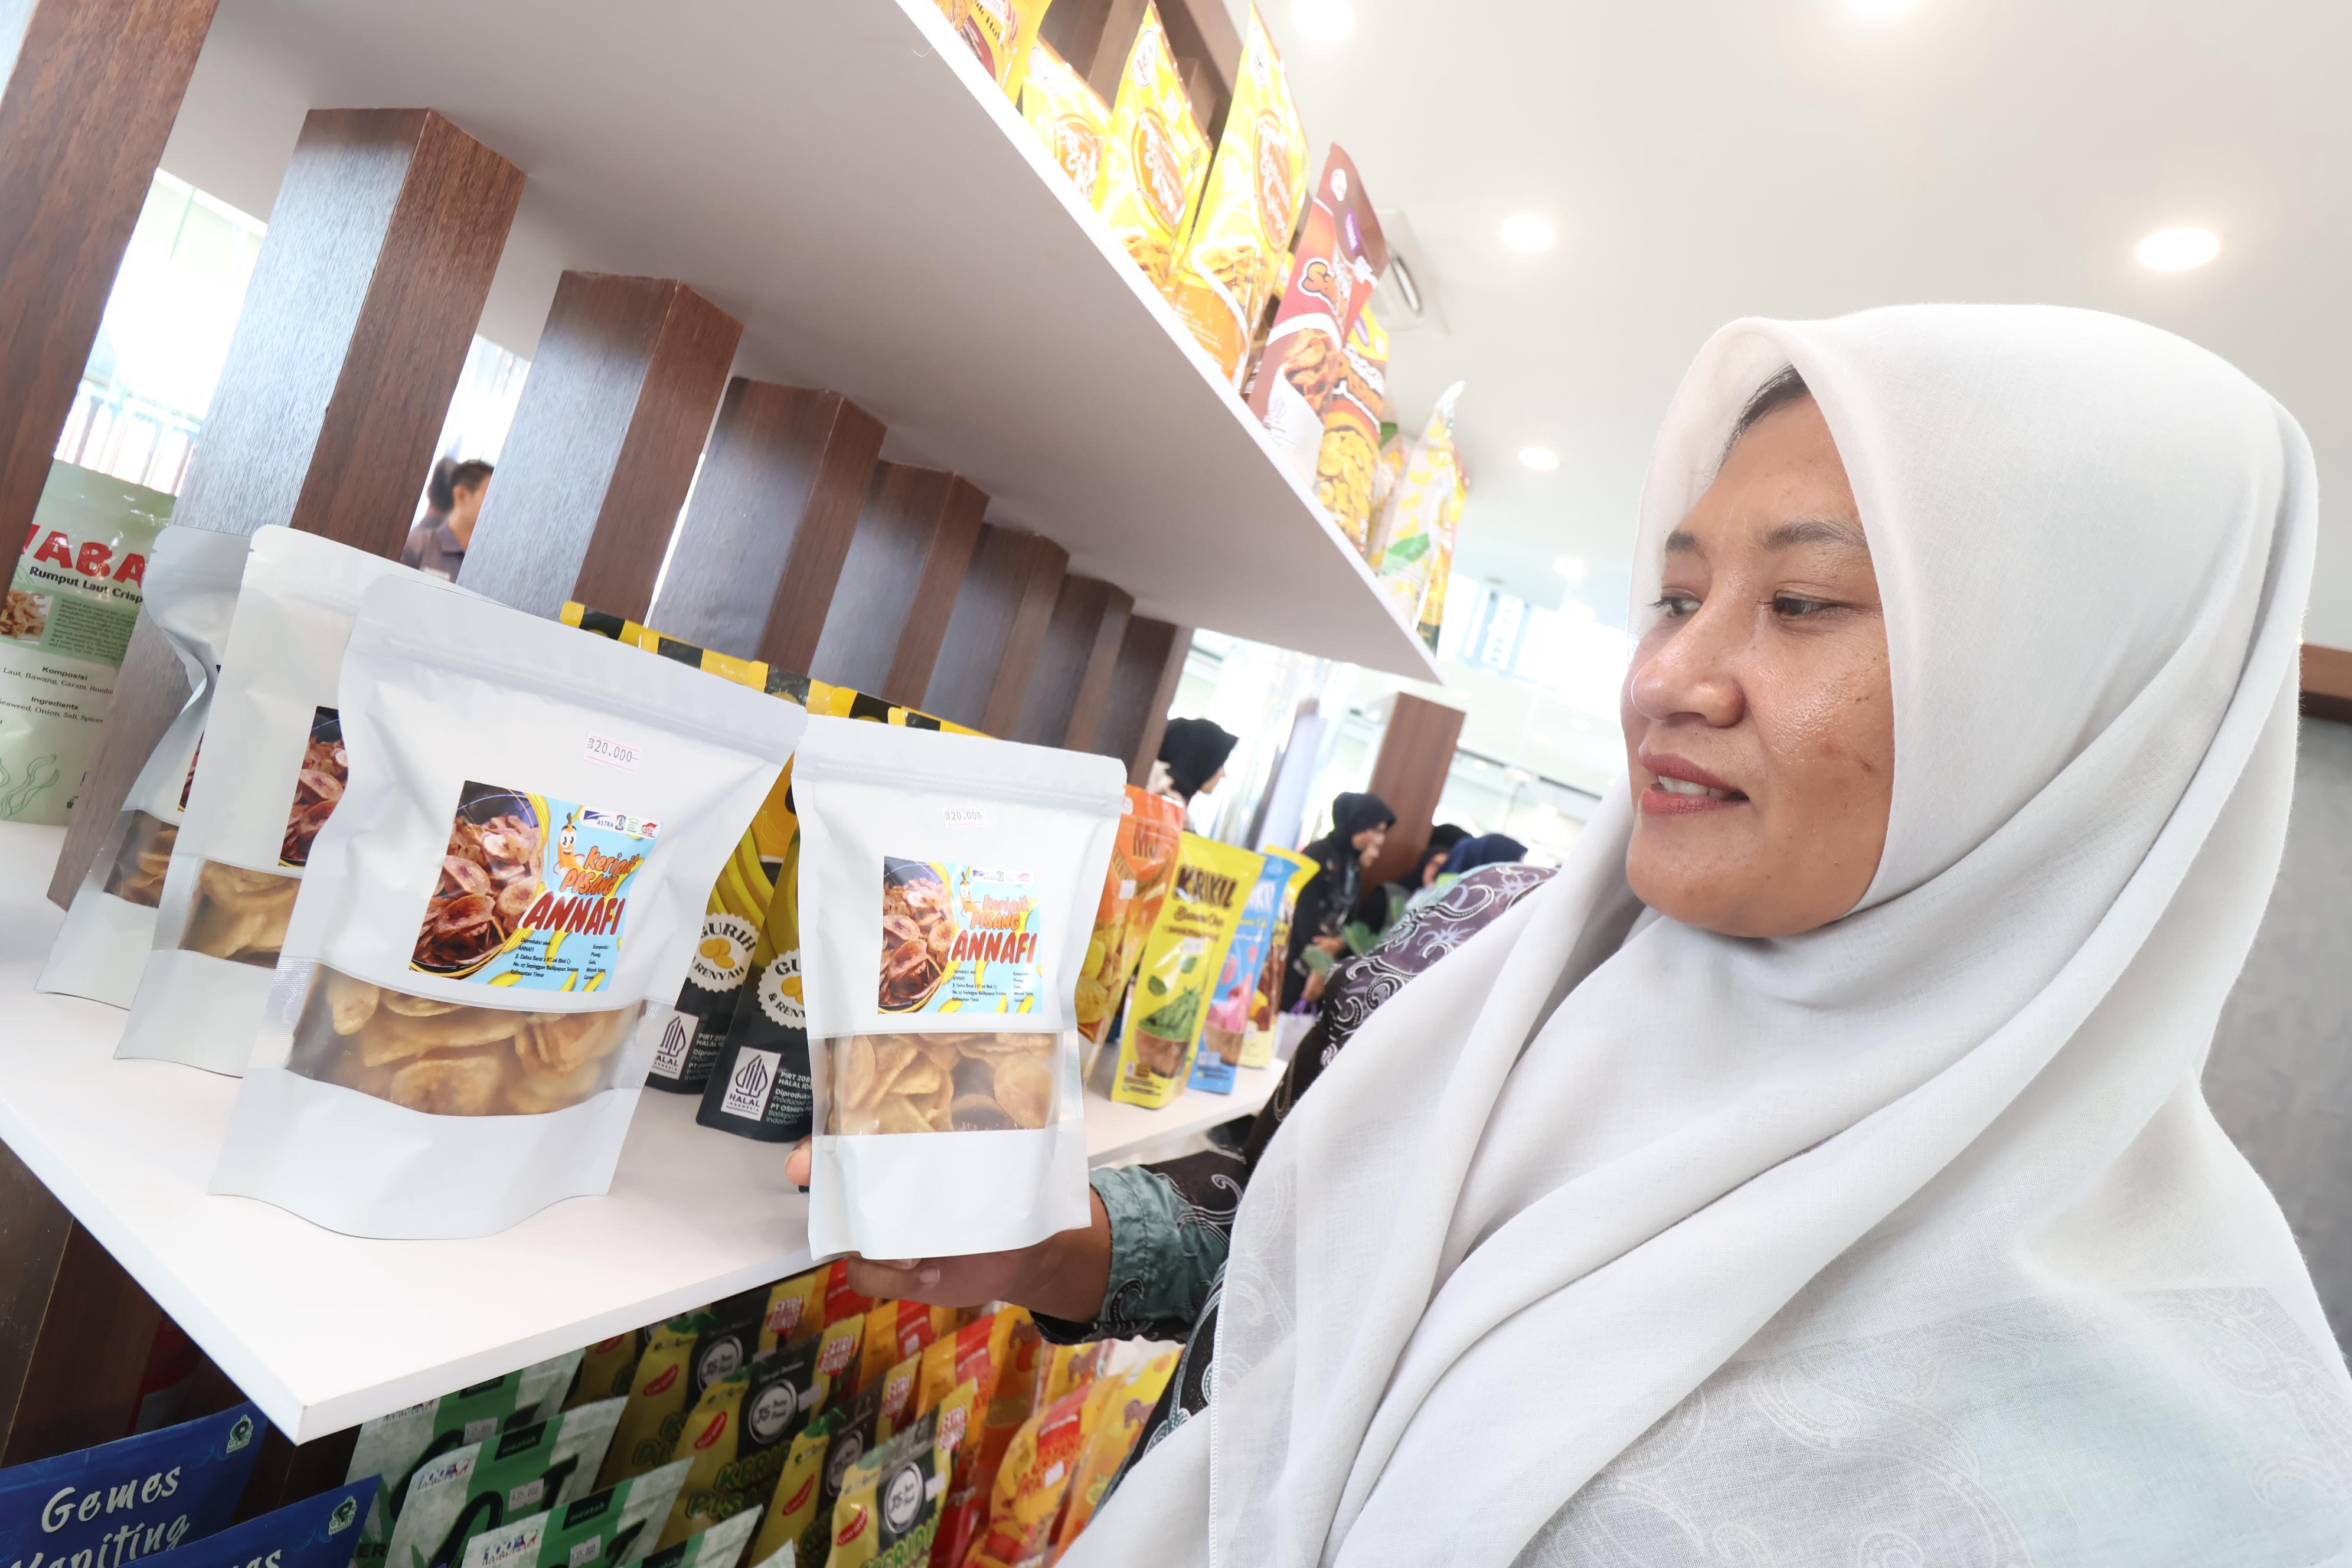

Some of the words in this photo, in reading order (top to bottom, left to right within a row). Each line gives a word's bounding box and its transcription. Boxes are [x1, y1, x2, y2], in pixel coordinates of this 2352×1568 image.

[30, 566, 79, 586] Rumput
[83, 580, 108, 594] Laut
[112, 588, 143, 605] Crisp
[43, 666, 88, 680] Komposisi
[31, 696, 79, 710] Ingredients
[81, 715, 103, 724] Spices
[559, 868, 619, 896] PISANG
[522, 891, 626, 935] ANNAFI
[969, 912, 1021, 931] PISANG
[700, 922, 756, 952] GURIH
[951, 929, 1037, 964] ANNAFI
[527, 962, 545, 971] Sepinggan
[694, 962, 744, 980] RENYAH
[655, 1055, 678, 1066] ALAL
[778, 1079, 801, 1088] HALAL
[780, 1072, 796, 1081] PIRT
[727, 1102, 759, 1112] INDONESIA
[729, 1093, 760, 1108] HALAL
[501, 1435, 537, 1453] mentah
[41, 1466, 181, 1533] Gemes
[569, 1502, 605, 1522] mentah
